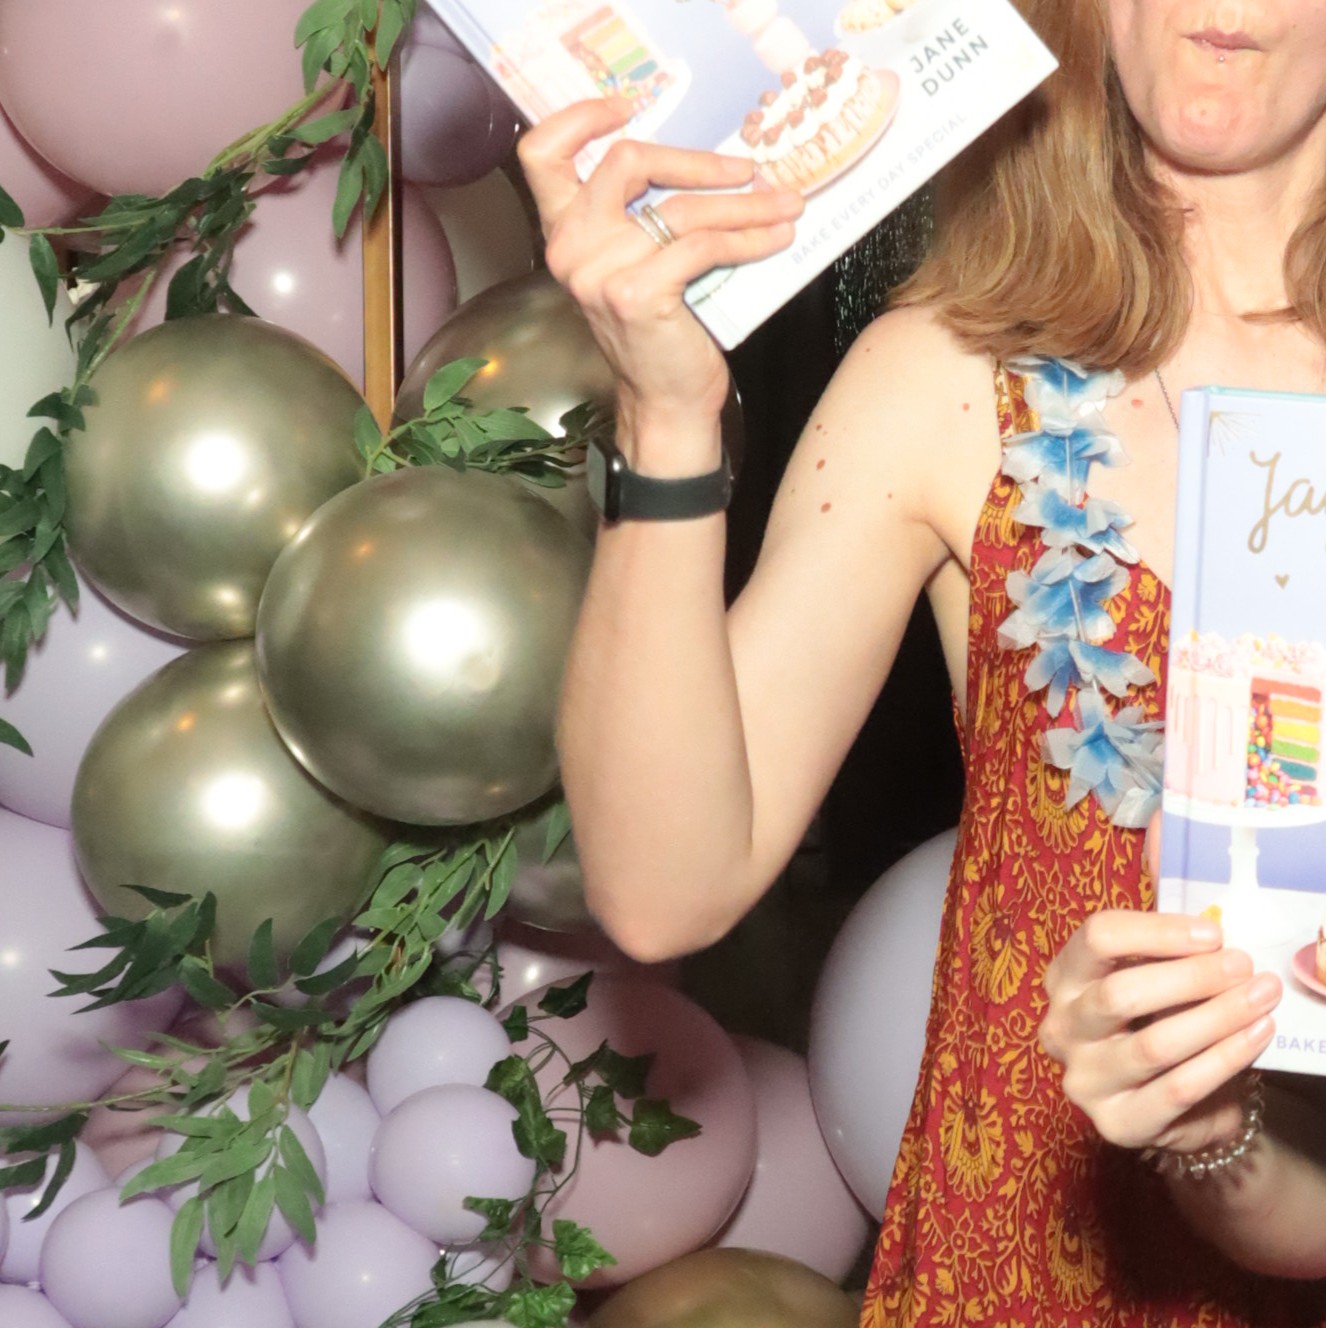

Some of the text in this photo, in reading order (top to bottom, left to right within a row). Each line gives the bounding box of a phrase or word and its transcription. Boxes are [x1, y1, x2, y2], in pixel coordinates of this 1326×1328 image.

[909, 18, 969, 73] JANE
[921, 35, 989, 96] DUNN
[791, 114, 967, 264] BAKE EVERY DAY SPECIAL
